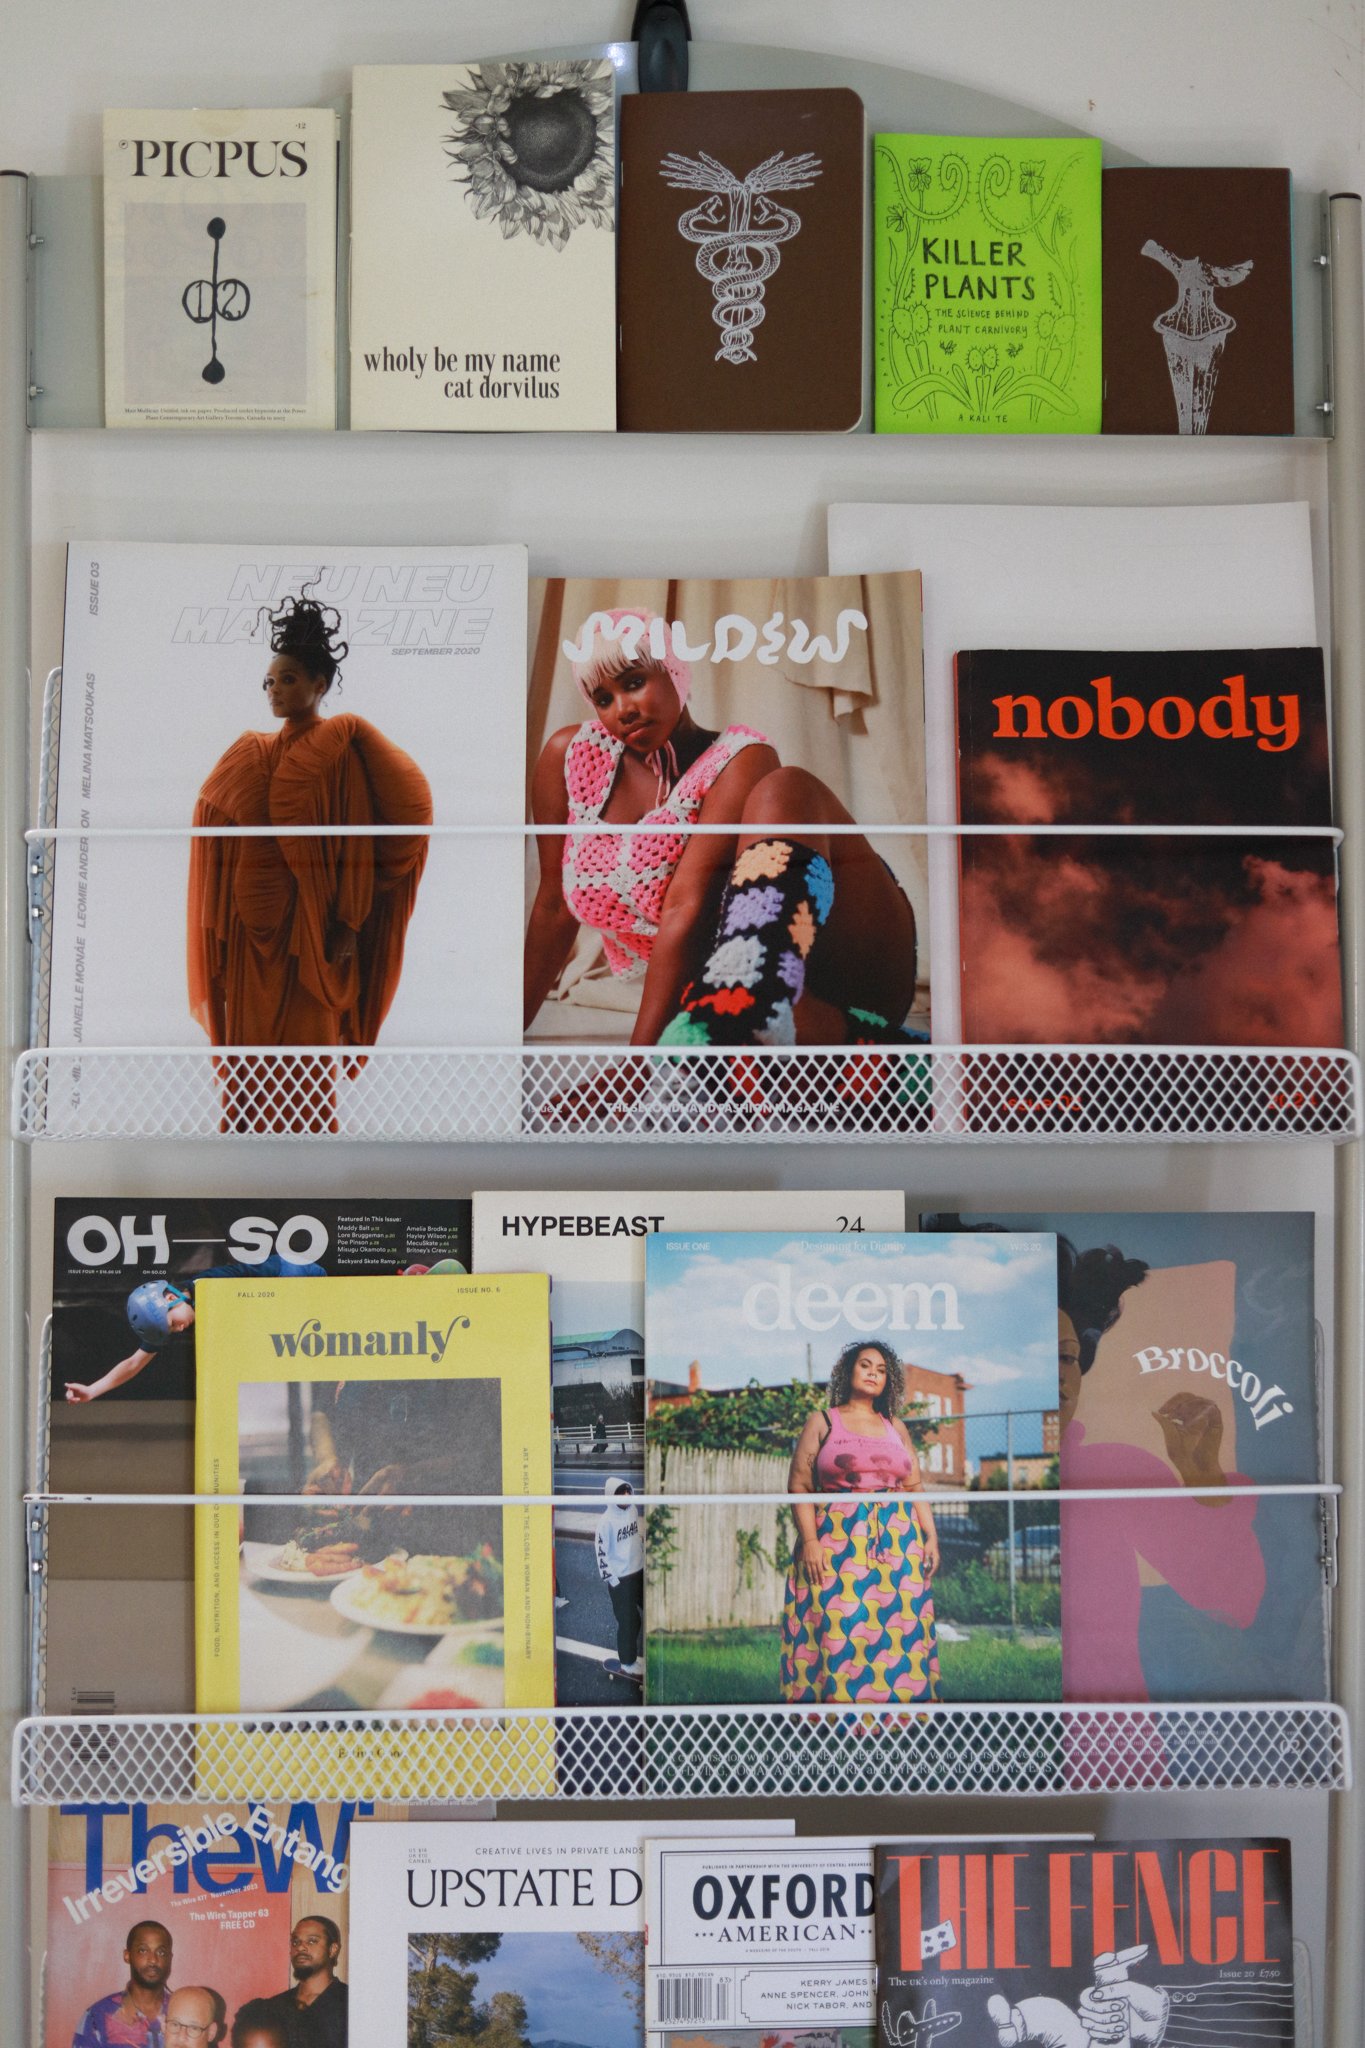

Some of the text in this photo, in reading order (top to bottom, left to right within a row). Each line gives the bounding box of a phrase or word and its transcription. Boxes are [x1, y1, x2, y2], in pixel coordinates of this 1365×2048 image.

[131, 140, 308, 178] PICPUS
[922, 237, 1026, 267] KILLER
[925, 273, 1035, 301] PLANTS
[935, 308, 1030, 319] THE SCIENCE BEHIND
[938, 324, 1028, 339] PLANT CARNIVORY
[364, 346, 561, 379] wholy be my name
[444, 375, 560, 399] cat dorvilus
[89, 561, 100, 616] ISSUE 03
[227, 564, 494, 602] NEU NEU
[171, 606, 494, 646] MAZINE
[562, 608, 868, 665] MILDEW
[391, 647, 481, 656] SEPTEMBER 2020
[83, 672, 96, 751] MATSOUKAS
[992, 674, 1300, 752] nobody
[81, 752, 93, 800] MELINA
[78, 808, 91, 880] ANDERON
[79, 881, 89, 929] LEOMIE
[74, 985, 84, 1043] JANELLE
[502, 1216, 665, 1237] HYPEBEAST
[836, 1216, 866, 1232] 24
[666, 1242, 711, 1251] ISSUE ONE
[855, 1240, 868, 1251] for
[743, 1264, 965, 1332] deem
[269, 1315, 471, 1363] womanly
[1132, 1346, 1294, 1431] Broccoli
[213, 1530, 220, 1539] IN
[62, 1805, 350, 1925] Irreversible Entang
[475, 1846, 644, 1856] CREATIVE LIVES IN PRIVATE LANDS
[170, 1900, 182, 1908] The
[182, 1897, 196, 1905] Wire
[210, 1887, 241, 1899] November
[407, 1868, 643, 1908] UPSTATE D
[693, 1873, 875, 1920] OXFORD
[189, 1908, 270, 1921] The Wire Tapper 63
[220, 1919, 256, 1930] FREE CD
[886, 1848, 1280, 1972] THE FENCE
[717, 1923, 856, 1943] AMERICAN
[800, 1979, 832, 1987] KERRY
[888, 1976, 907, 1987] The
[929, 1975, 950, 1988] only
[951, 1975, 994, 1987] magazine
[1219, 1969, 1242, 1979] Issue
[1243, 1970, 1255, 1978] 20
[760, 1991, 787, 1999] ANNE
[790, 1990, 839, 1999] SPENCER,
[842, 1990, 869, 1998] JOHN
[786, 2001, 873, 2010] NICK TABOR, AND
